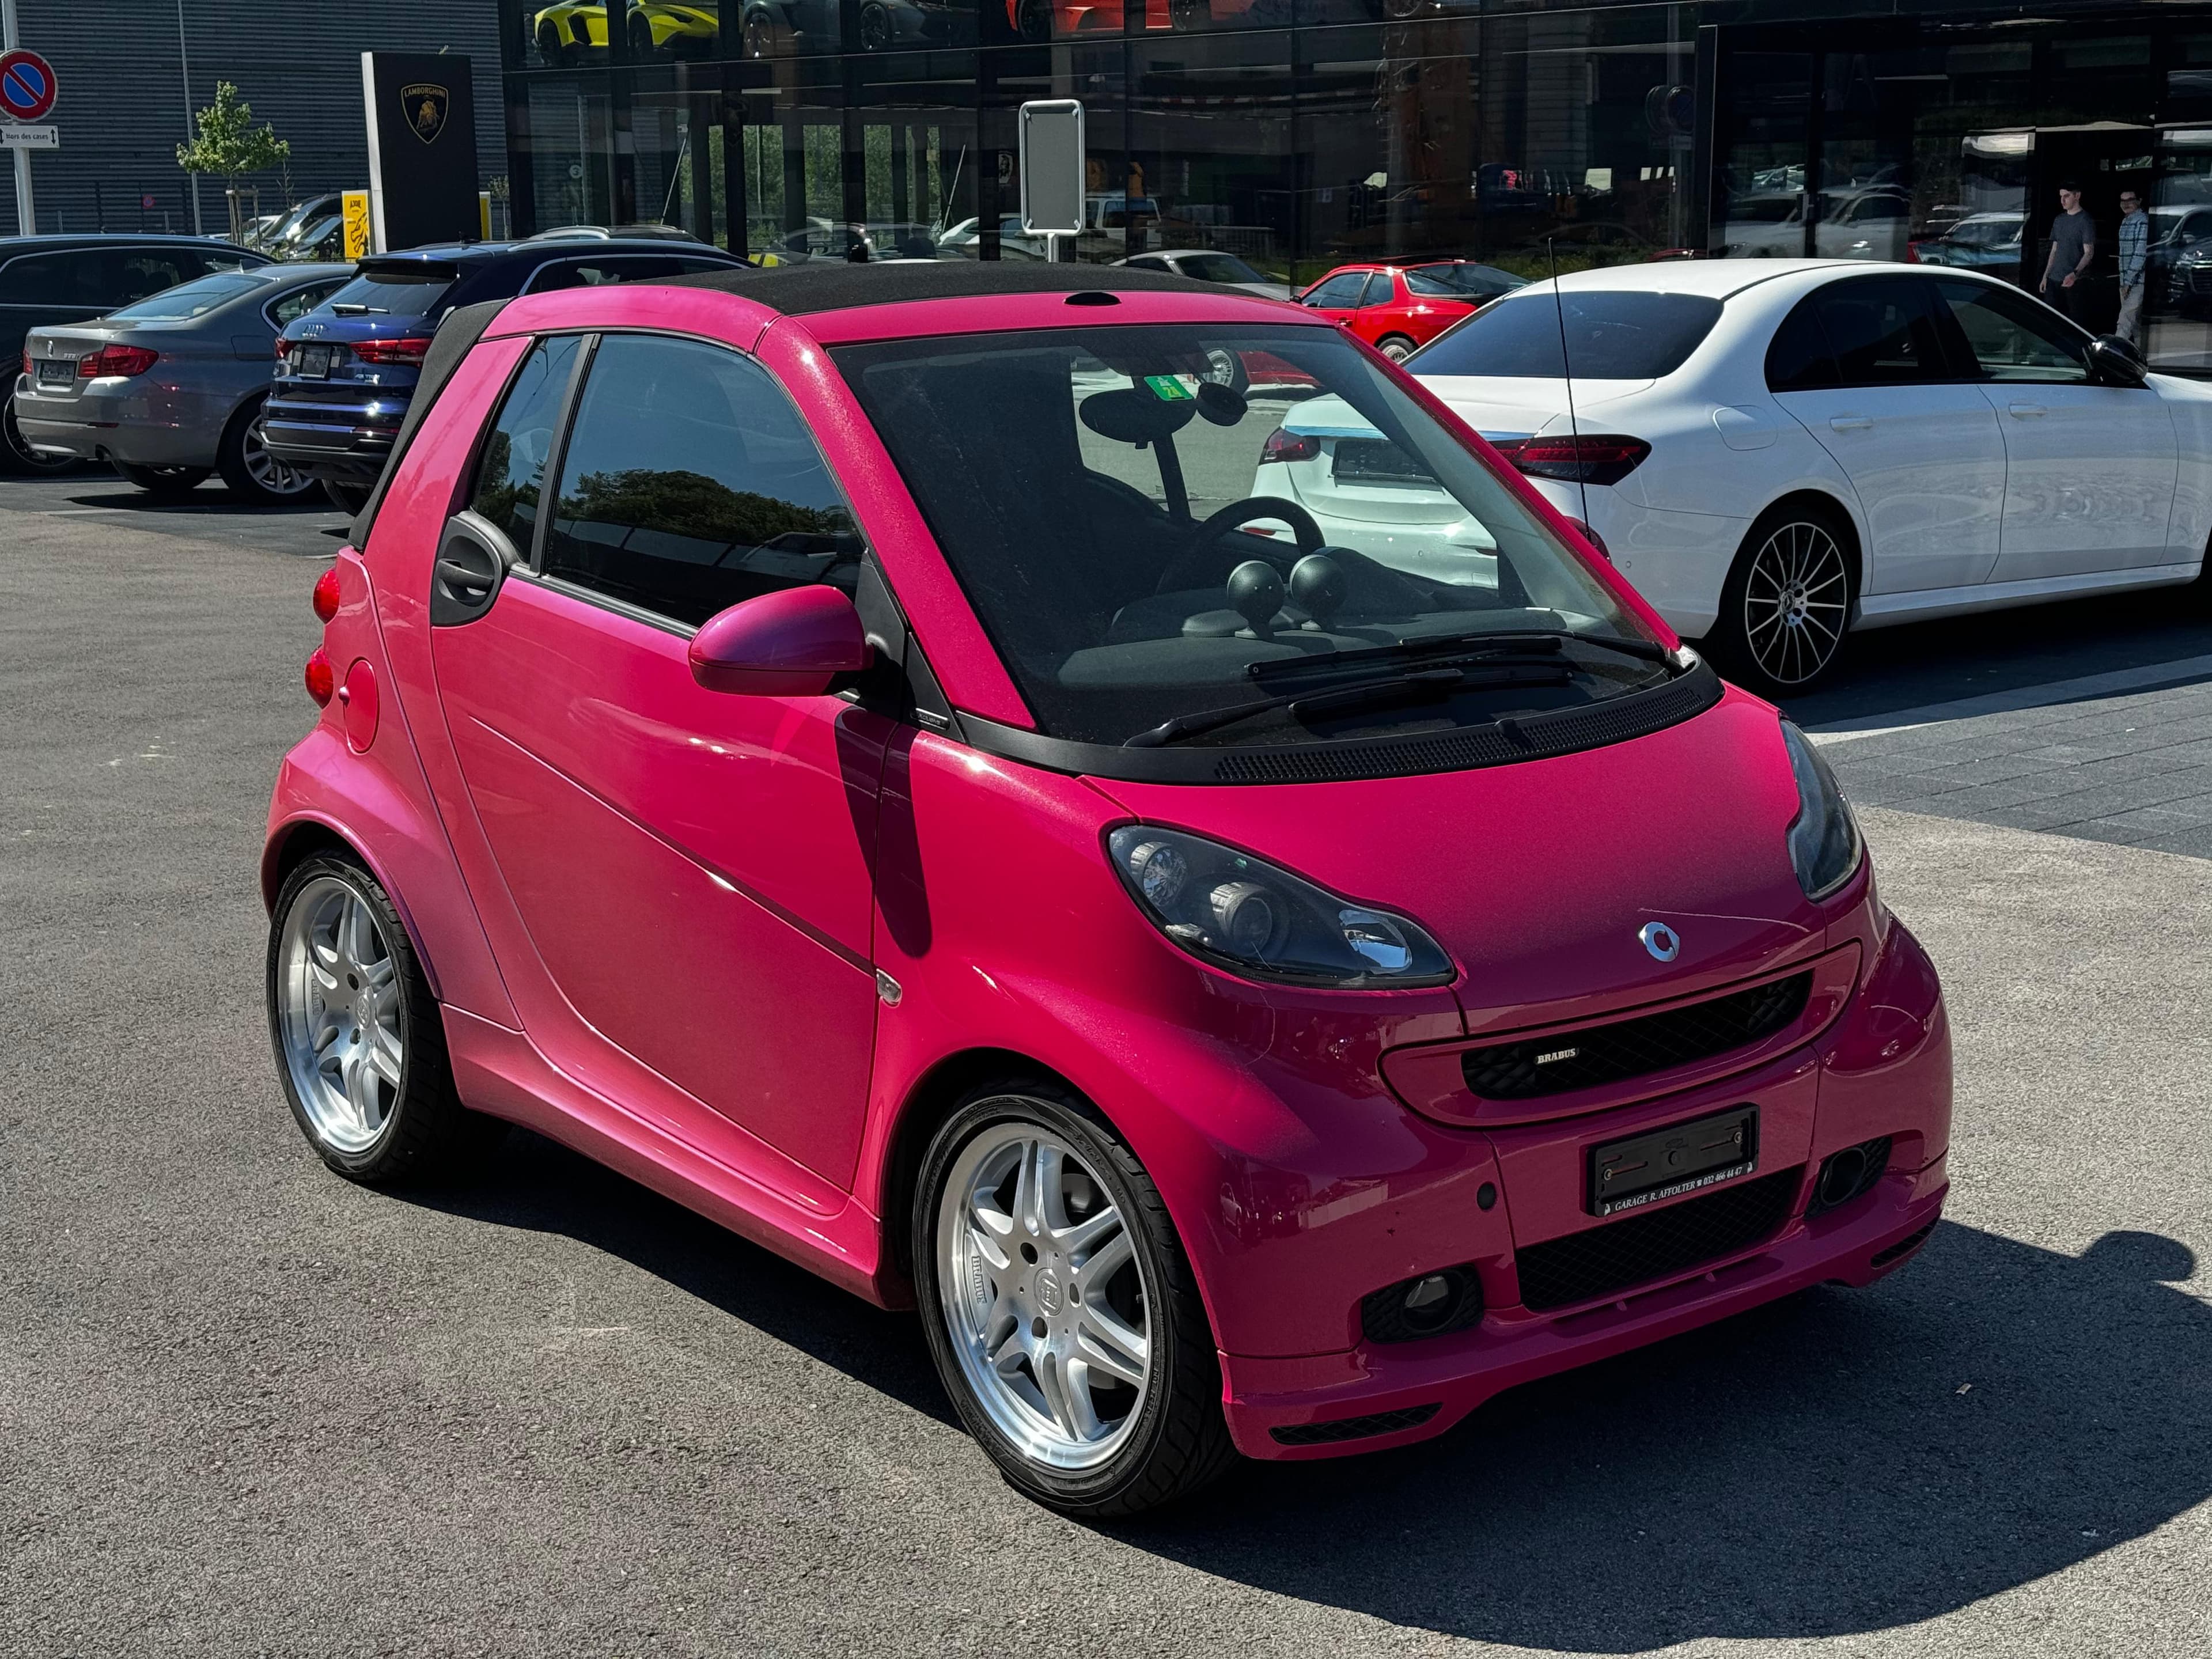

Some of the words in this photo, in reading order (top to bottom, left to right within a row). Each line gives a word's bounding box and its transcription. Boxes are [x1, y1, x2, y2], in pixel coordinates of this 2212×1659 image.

[404, 86, 445, 97] LAMBORGHINI
[1537, 1048, 1575, 1064] BRABUS
[1615, 1194, 1647, 1211] GARAGE
[1650, 1192, 1657, 1202] R.
[1658, 1180, 1696, 1199] AFFOLTER
[1703, 1175, 1714, 1185] 032
[1715, 1171, 1726, 1182] 466
[1726, 1168, 1734, 1179] 44
[1734, 1166, 1743, 1176] 47
[972, 1256, 987, 1305] BRABUS
